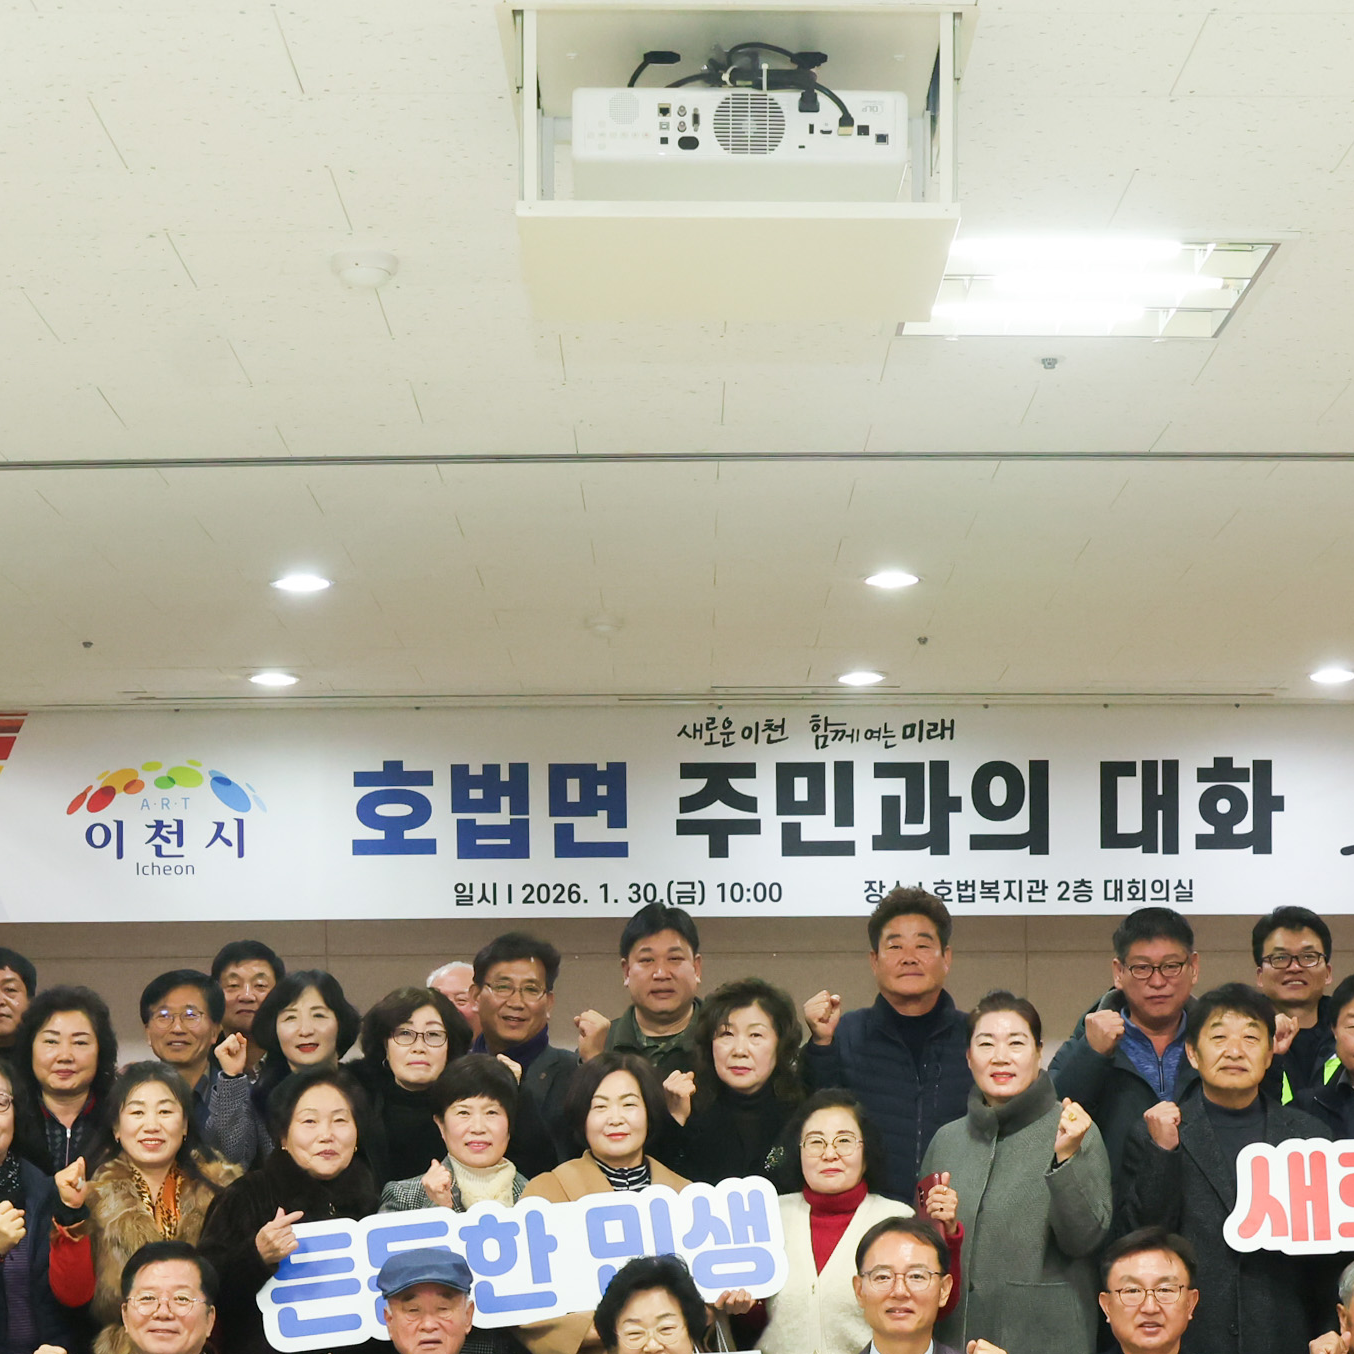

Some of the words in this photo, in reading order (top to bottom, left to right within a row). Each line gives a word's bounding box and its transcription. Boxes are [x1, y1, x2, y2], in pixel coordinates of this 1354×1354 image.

[677, 716, 736, 748] 새로운
[741, 717, 789, 745] 이천
[809, 714, 860, 750] 함께
[864, 722, 897, 749] 여는
[902, 718, 955, 741] 미래
[352, 760, 629, 860] 호법면
[676, 759, 1050, 859] 주민과의
[1100, 756, 1285, 856] 대화
[136, 862, 195, 876] Icheon
[454, 881, 497, 906] 일시
[521, 884, 588, 904] 2026.
[599, 884, 619, 904] 1.
[716, 882, 783, 904] 10:00
[864, 880, 901, 904] 장
[933, 879, 1049, 903] 호법복지관
[1057, 879, 1094, 903] 2층
[1103, 878, 1194, 903] 대회의실
[586, 1188, 776, 1298] 민생
